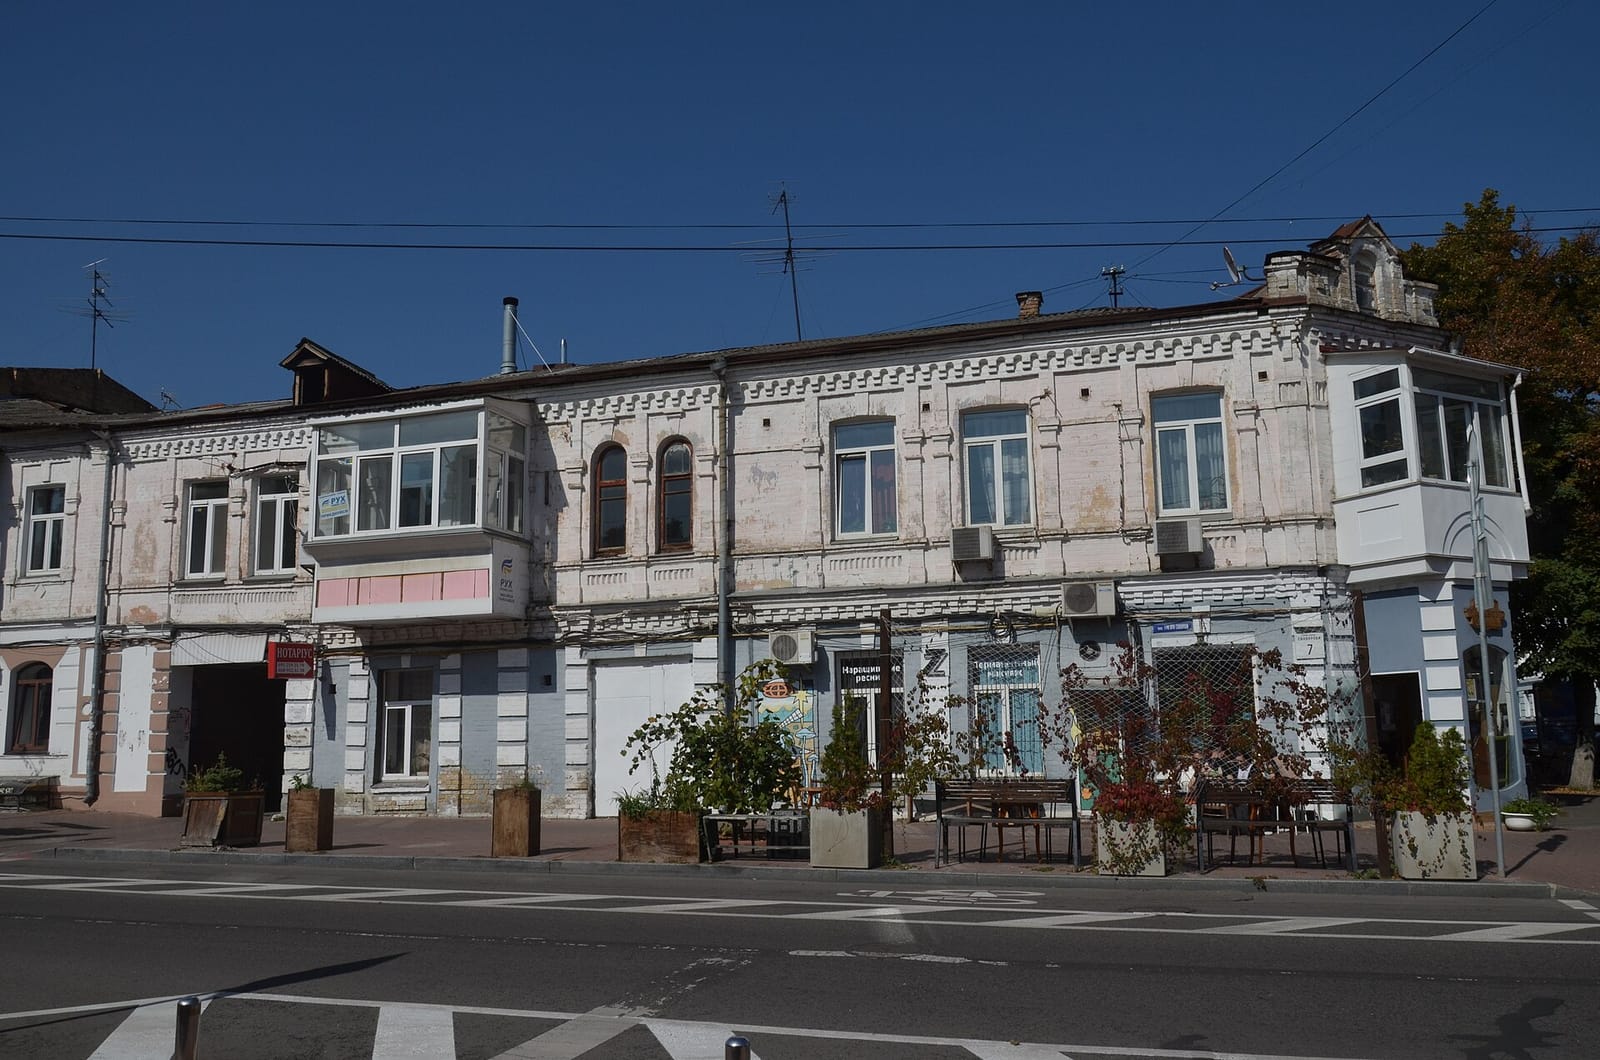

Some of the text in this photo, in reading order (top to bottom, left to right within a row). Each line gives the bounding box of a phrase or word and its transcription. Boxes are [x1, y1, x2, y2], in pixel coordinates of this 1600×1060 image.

[331, 496, 346, 504] РУХ
[500, 578, 513, 589] РУХ
[277, 647, 313, 659] НОТАРІУС
[1307, 643, 1313, 655] 7
[842, 665, 901, 675] Наращивие
[856, 674, 881, 684] ресни
